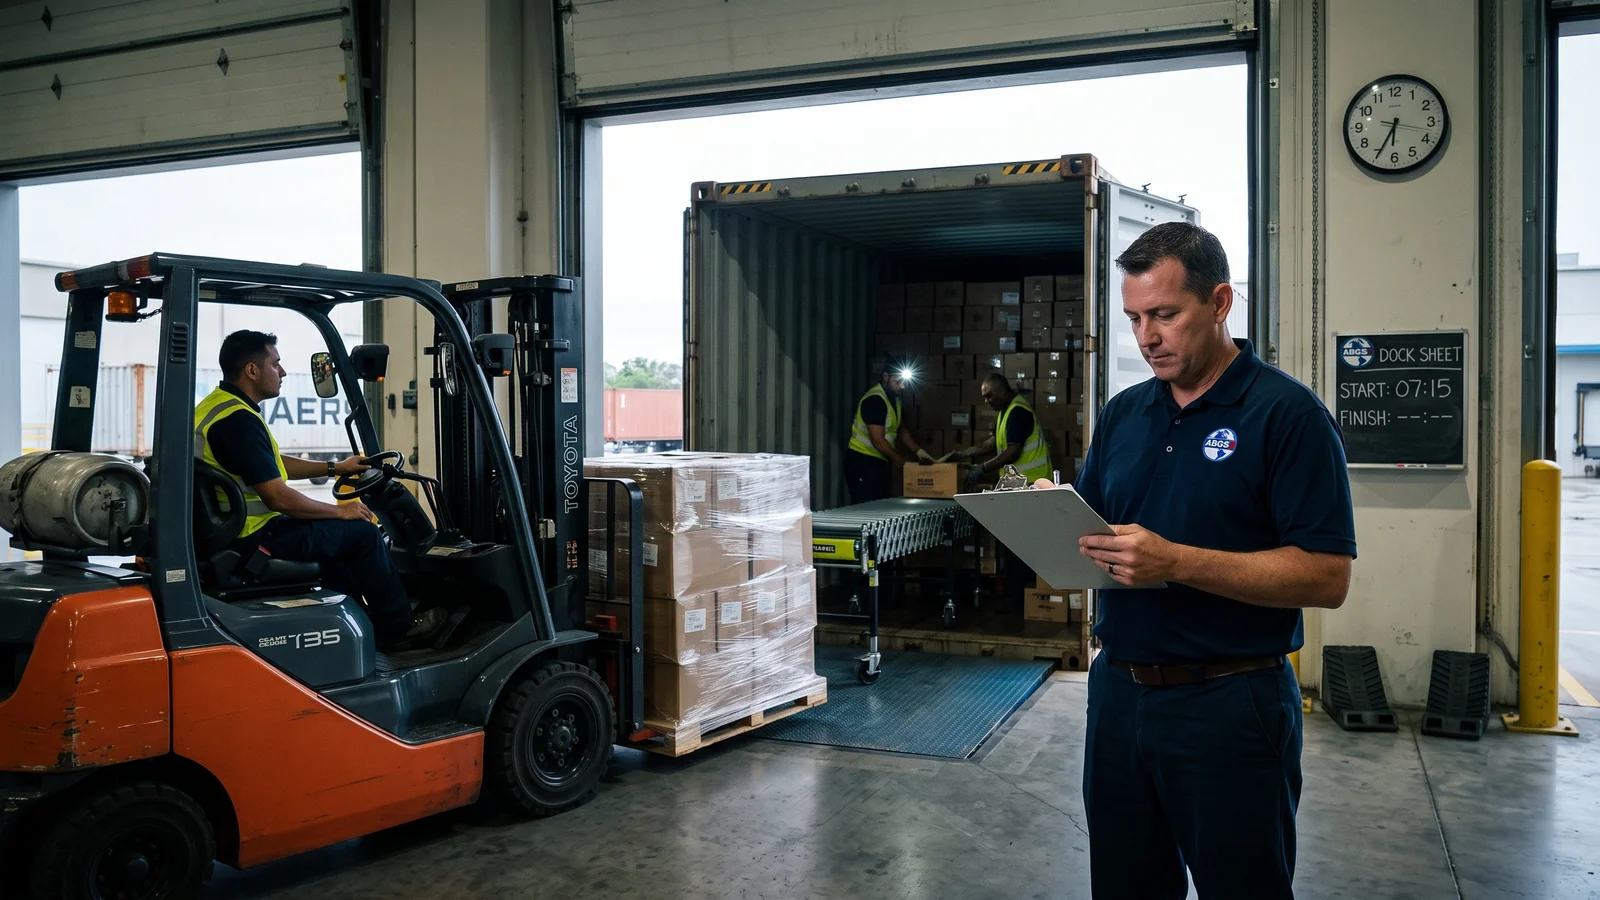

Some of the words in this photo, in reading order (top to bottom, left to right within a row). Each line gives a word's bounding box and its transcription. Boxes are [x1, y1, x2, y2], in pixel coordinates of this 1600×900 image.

[1388, 86, 1401, 97] 12
[1409, 90, 1415, 100] 1
[1373, 93, 1383, 103] 11
[1422, 100, 1430, 111] 2
[1359, 106, 1372, 117] 10
[1426, 116, 1435, 127] 3
[1355, 122, 1363, 133] 9
[1360, 137, 1368, 148] 8
[1421, 133, 1430, 144] 4
[1408, 146, 1416, 157] 5
[1390, 152, 1399, 163] 6
[1343, 348, 1368, 356] ABGS
[1379, 347, 1416, 363] DOCK
[1419, 346, 1462, 362] SHEET
[1340, 382, 1390, 399] START:
[1395, 378, 1452, 398] 07:15
[259, 396, 352, 425] AER
[1340, 409, 1391, 427] FINISH:
[1205, 439, 1230, 449] ABGS
[564, 414, 579, 514] TOYOTA
